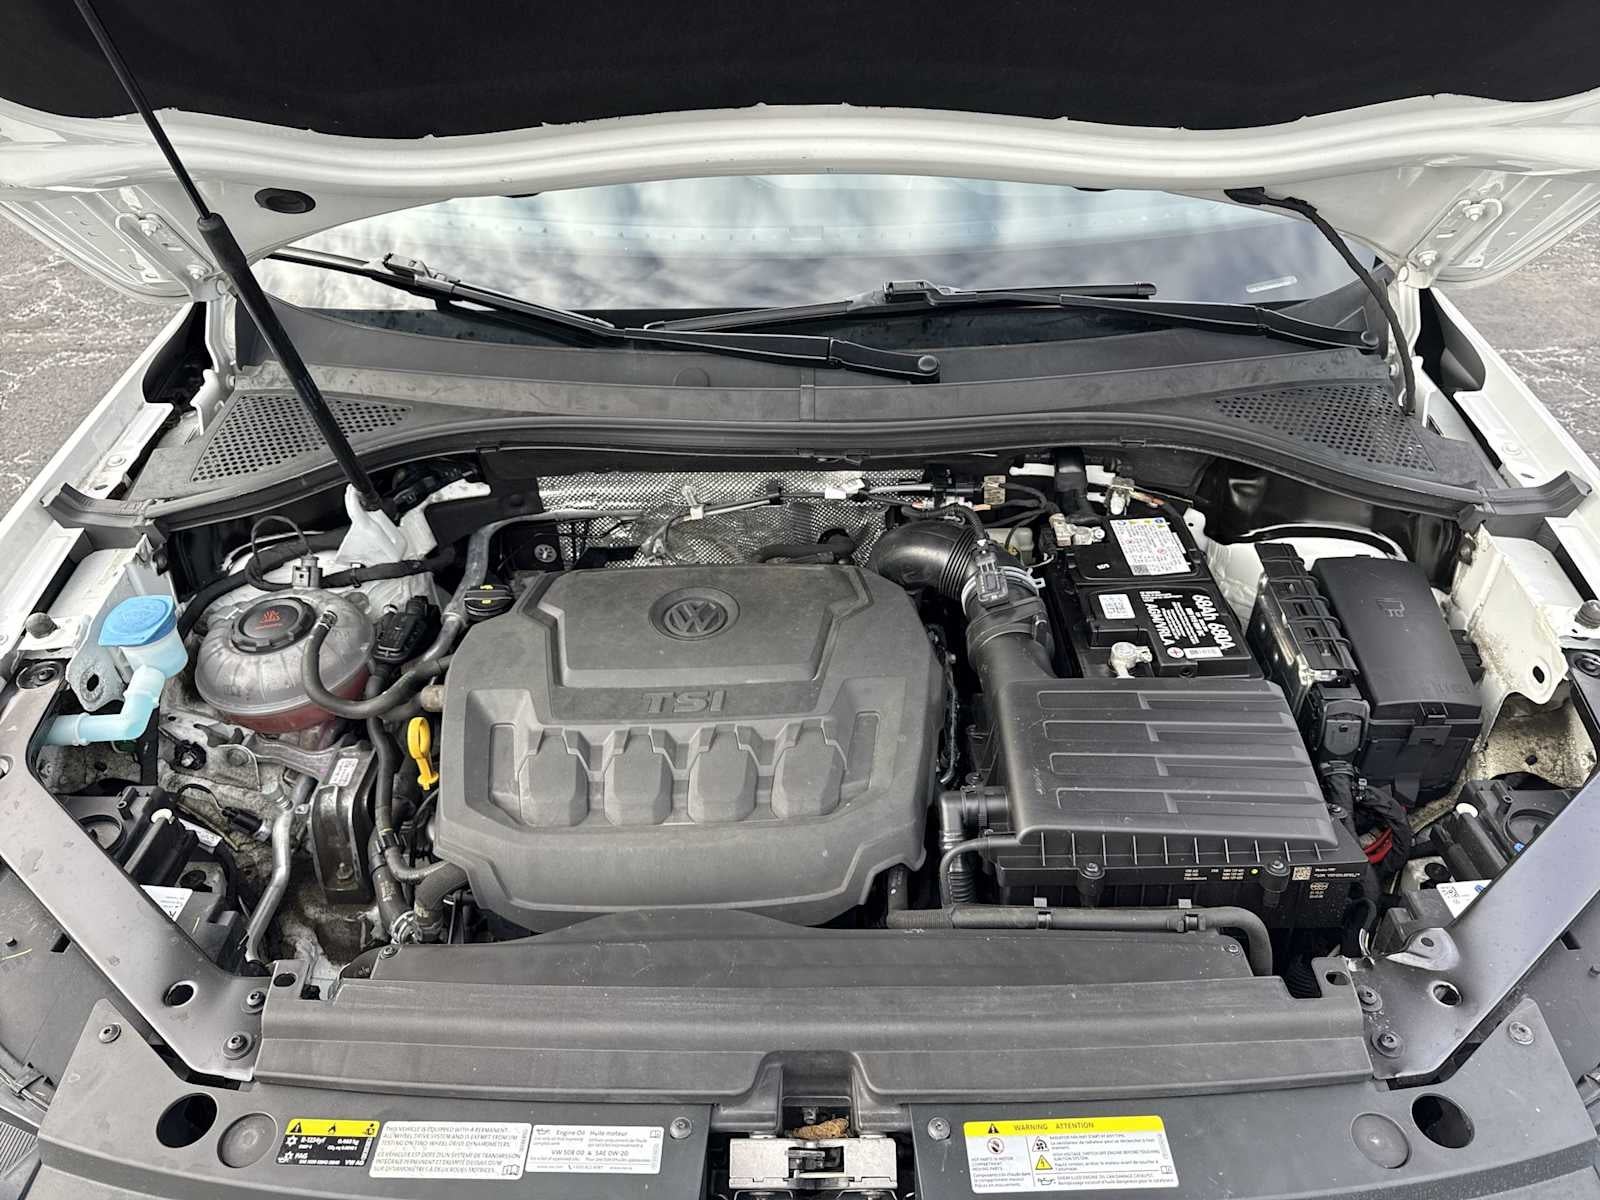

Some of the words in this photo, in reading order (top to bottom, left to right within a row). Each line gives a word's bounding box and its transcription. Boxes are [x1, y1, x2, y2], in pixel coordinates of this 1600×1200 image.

[1192, 594, 1219, 621] 68Ah
[1208, 623, 1236, 649] 680A
[643, 689, 727, 713] TSI
[1014, 1123, 1048, 1131] WARNING
[1055, 1121, 1095, 1129] ATTENTION
